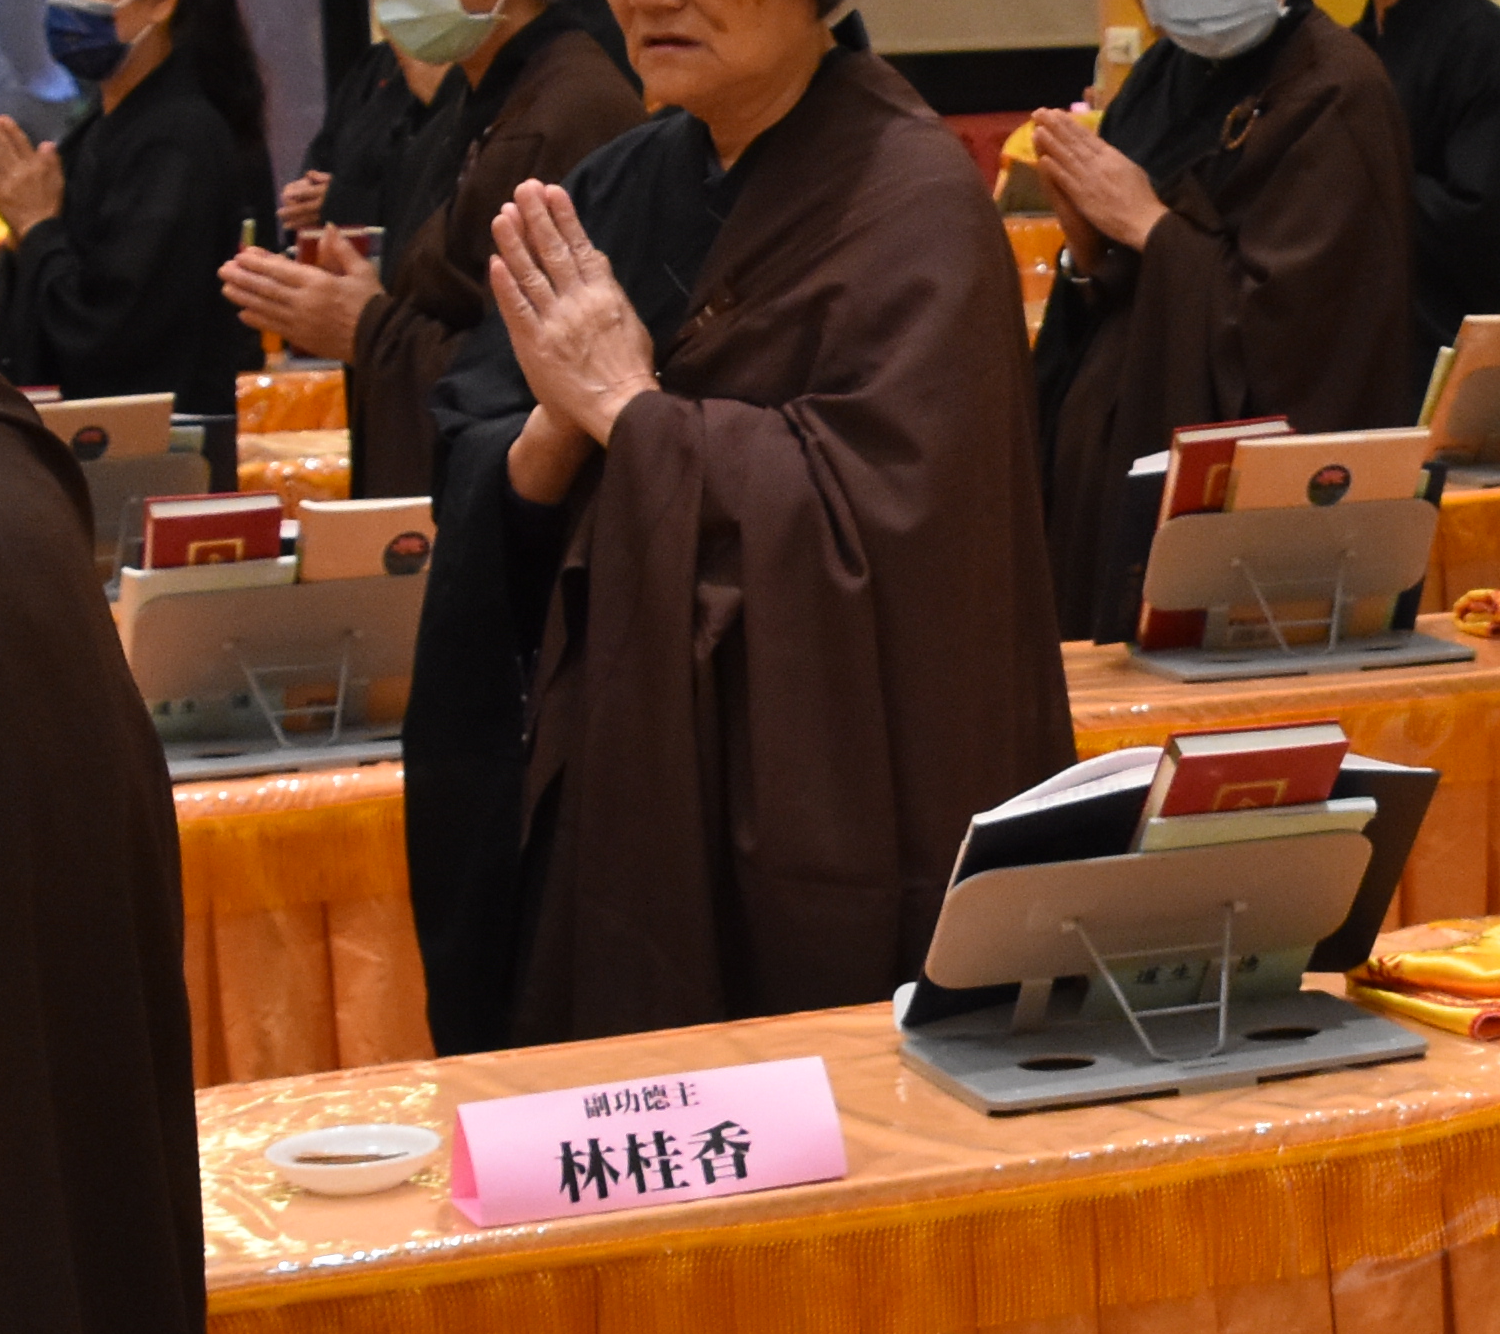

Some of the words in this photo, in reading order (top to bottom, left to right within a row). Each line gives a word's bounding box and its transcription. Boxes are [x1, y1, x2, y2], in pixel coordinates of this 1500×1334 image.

[583, 1081, 702, 1120] 副功德主
[554, 1119, 752, 1204] 林桂香
